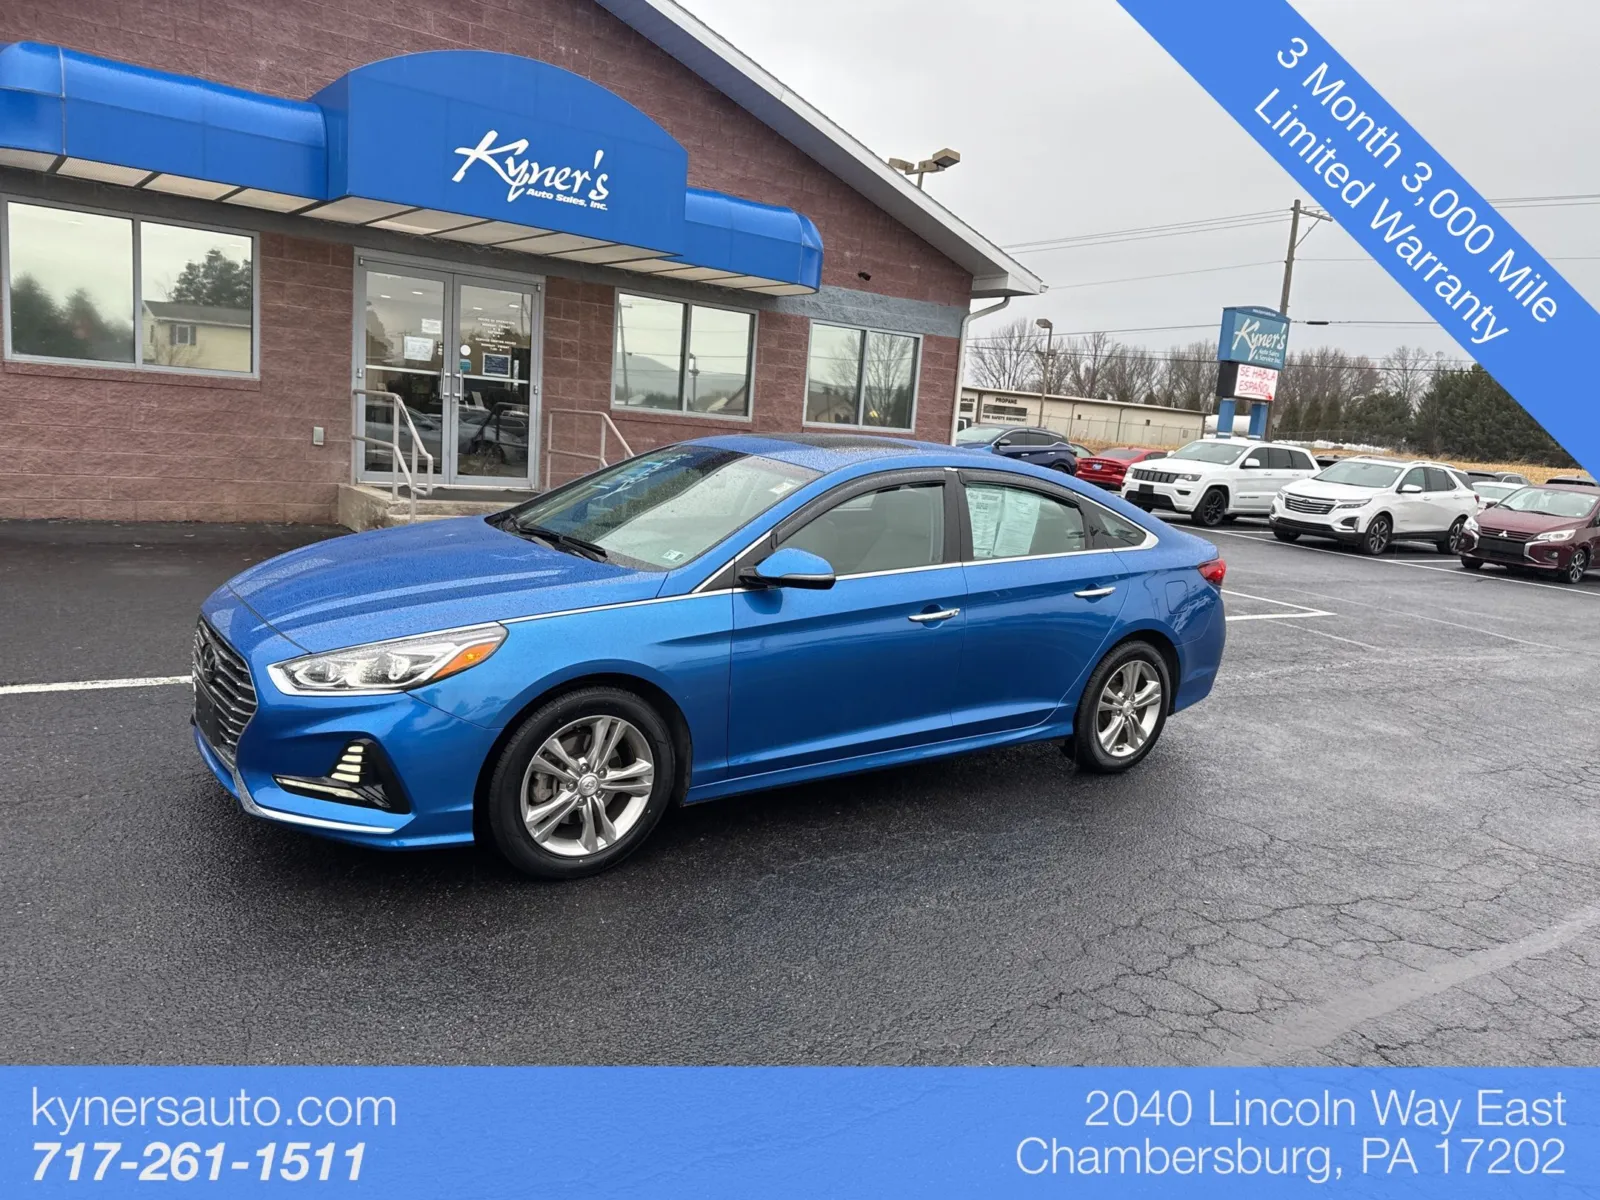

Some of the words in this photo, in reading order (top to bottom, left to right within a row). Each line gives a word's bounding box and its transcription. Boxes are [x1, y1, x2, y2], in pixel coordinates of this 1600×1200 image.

[452, 129, 610, 202] Kyner's
[526, 189, 553, 200] Auto
[555, 195, 588, 207] Sales,
[589, 200, 608, 211] Inc.
[1232, 318, 1286, 361] Kyner's
[1240, 367, 1250, 377] SE
[1252, 369, 1276, 381] HABLA
